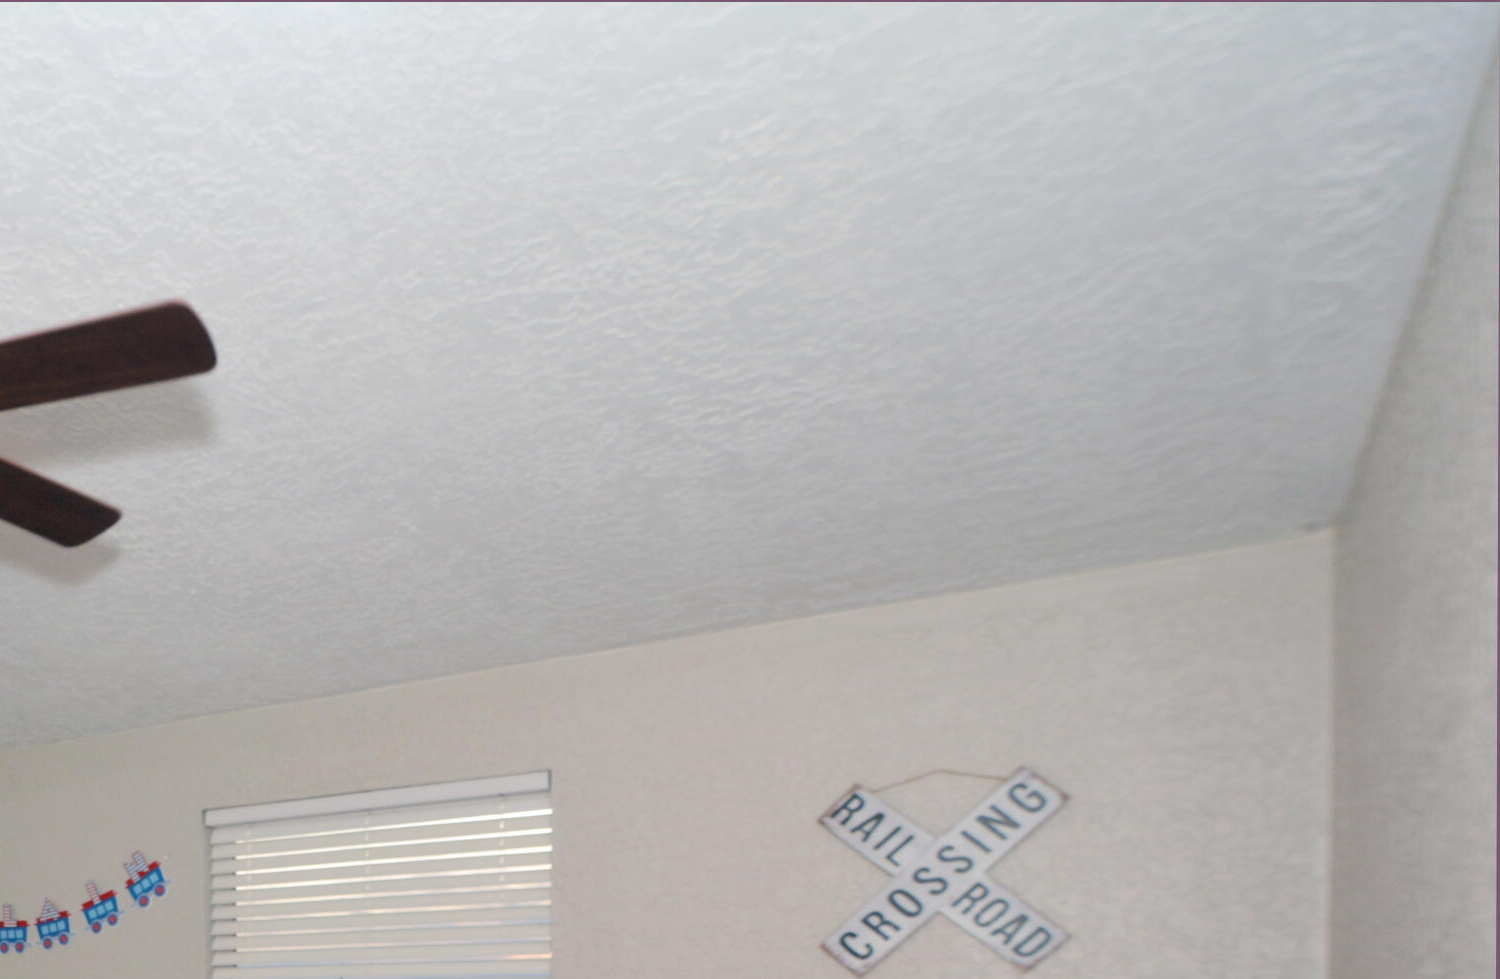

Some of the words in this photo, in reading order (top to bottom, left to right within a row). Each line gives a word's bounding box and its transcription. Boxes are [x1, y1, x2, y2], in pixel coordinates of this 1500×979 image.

[829, 792, 915, 868] RAIL
[838, 781, 1049, 961] CROSSING
[950, 881, 1054, 959] ROAD
